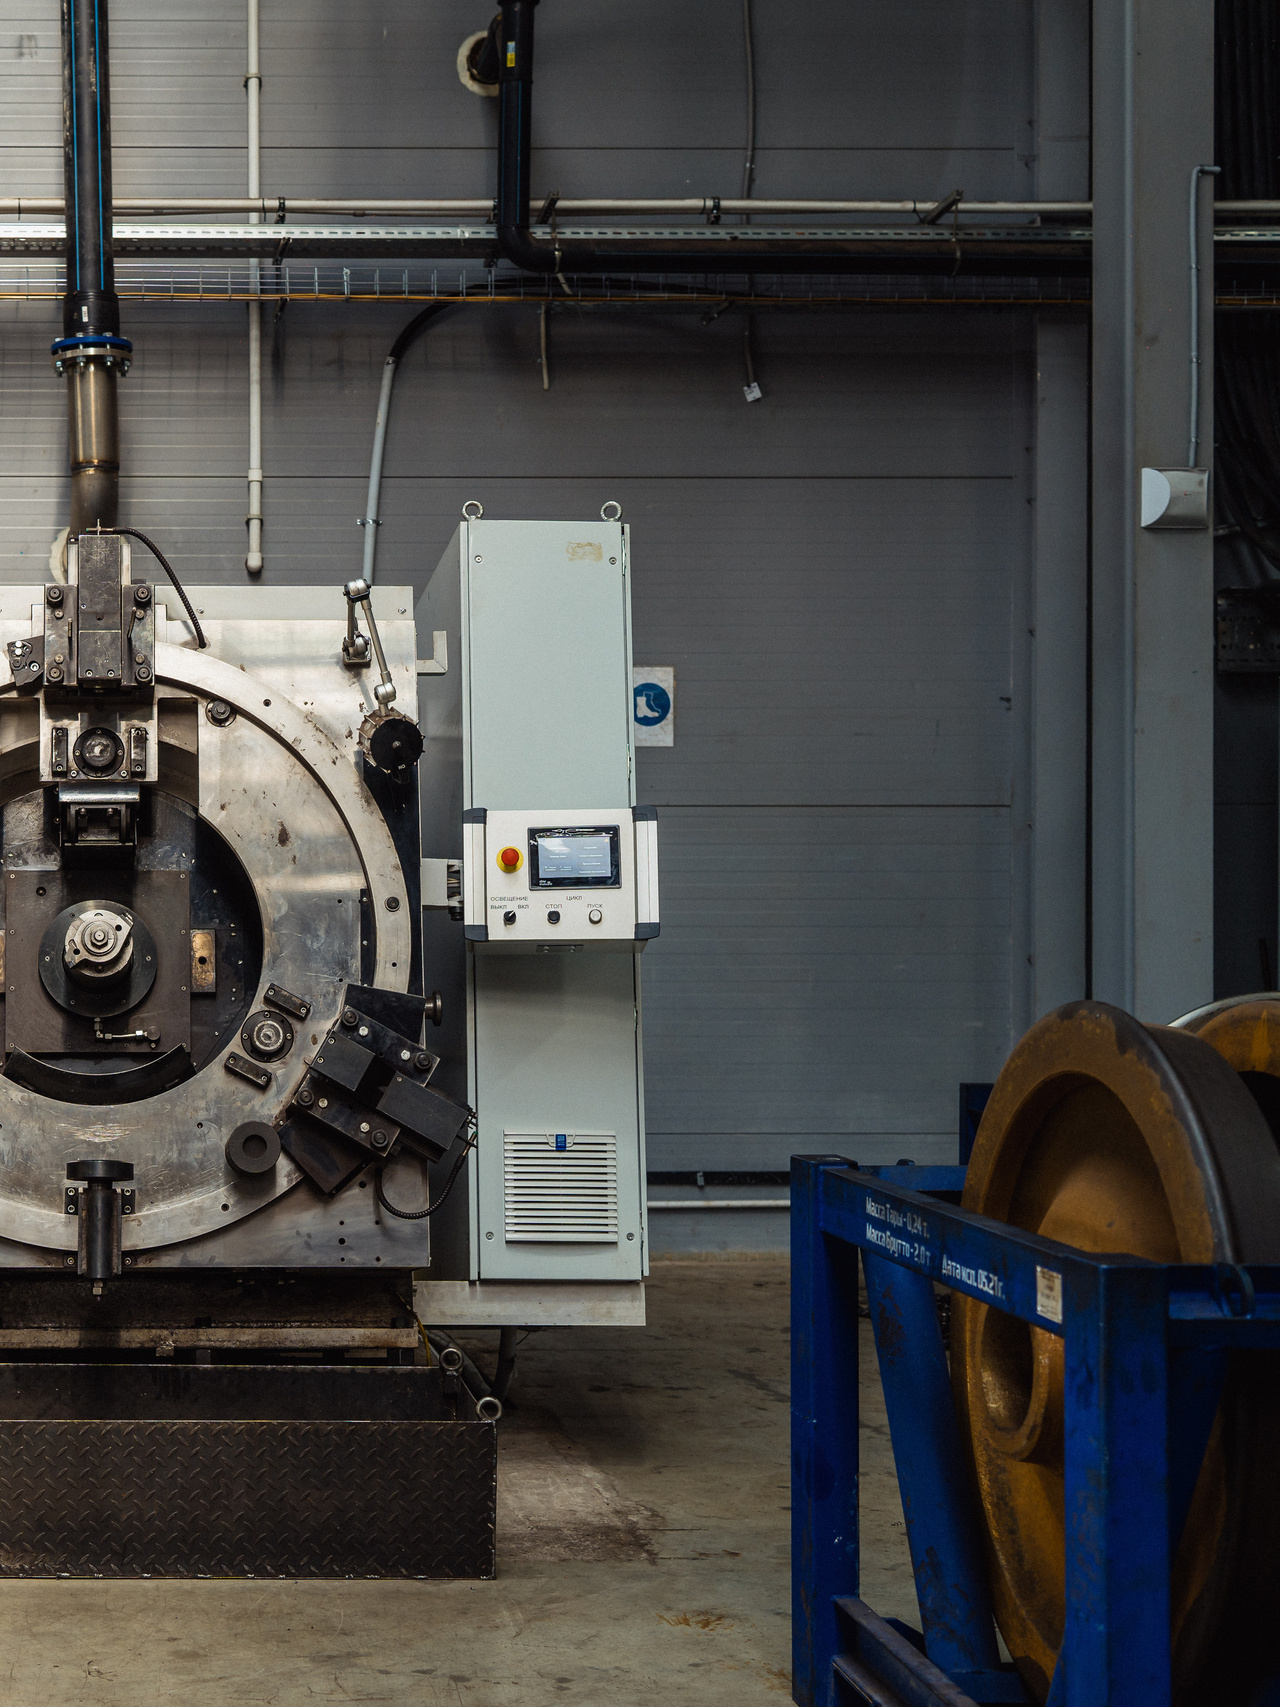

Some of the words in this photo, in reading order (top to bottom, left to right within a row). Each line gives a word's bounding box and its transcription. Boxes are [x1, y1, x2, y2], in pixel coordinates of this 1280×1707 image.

[865, 1196, 886, 1221] Масса
[885, 1203, 903, 1228] Тары
[865, 1222, 886, 1248] Масса
[941, 1254, 961, 1281] Дата
